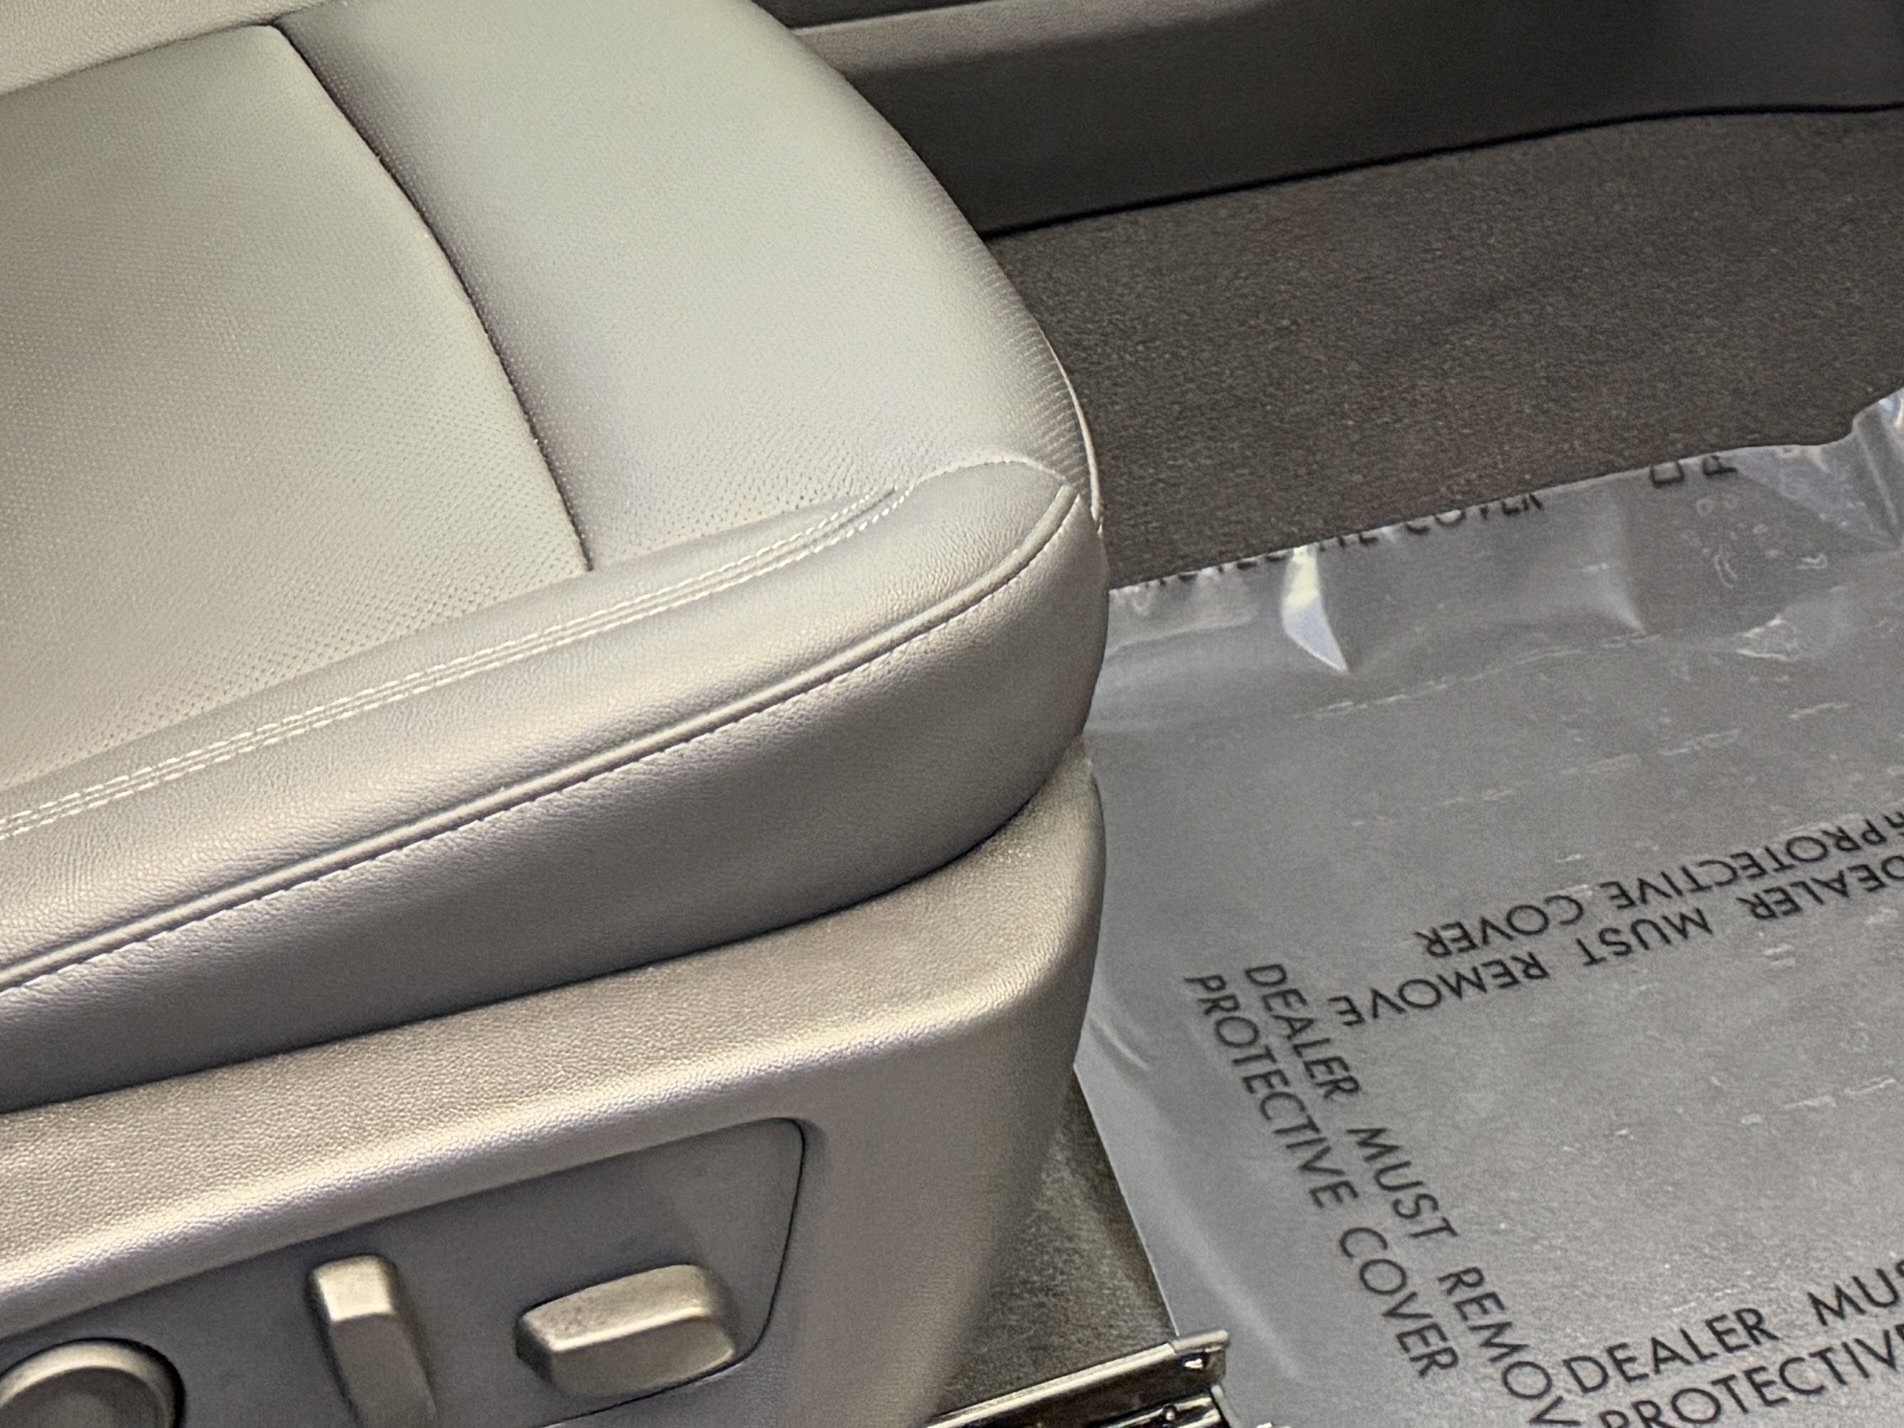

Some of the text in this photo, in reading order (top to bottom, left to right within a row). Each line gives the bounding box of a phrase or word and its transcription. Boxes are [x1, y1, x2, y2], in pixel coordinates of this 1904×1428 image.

[1415, 818, 1886, 959] PROTECTIVE COVER
[1584, 904, 1712, 968] MUST
[1331, 949, 1548, 1027] REMOVE
[1185, 974, 1458, 1381] PROTECTIVE COVER
[1243, 963, 1582, 1428] DEALER MUST REMOV
[1563, 1308, 1779, 1394] DEALER
